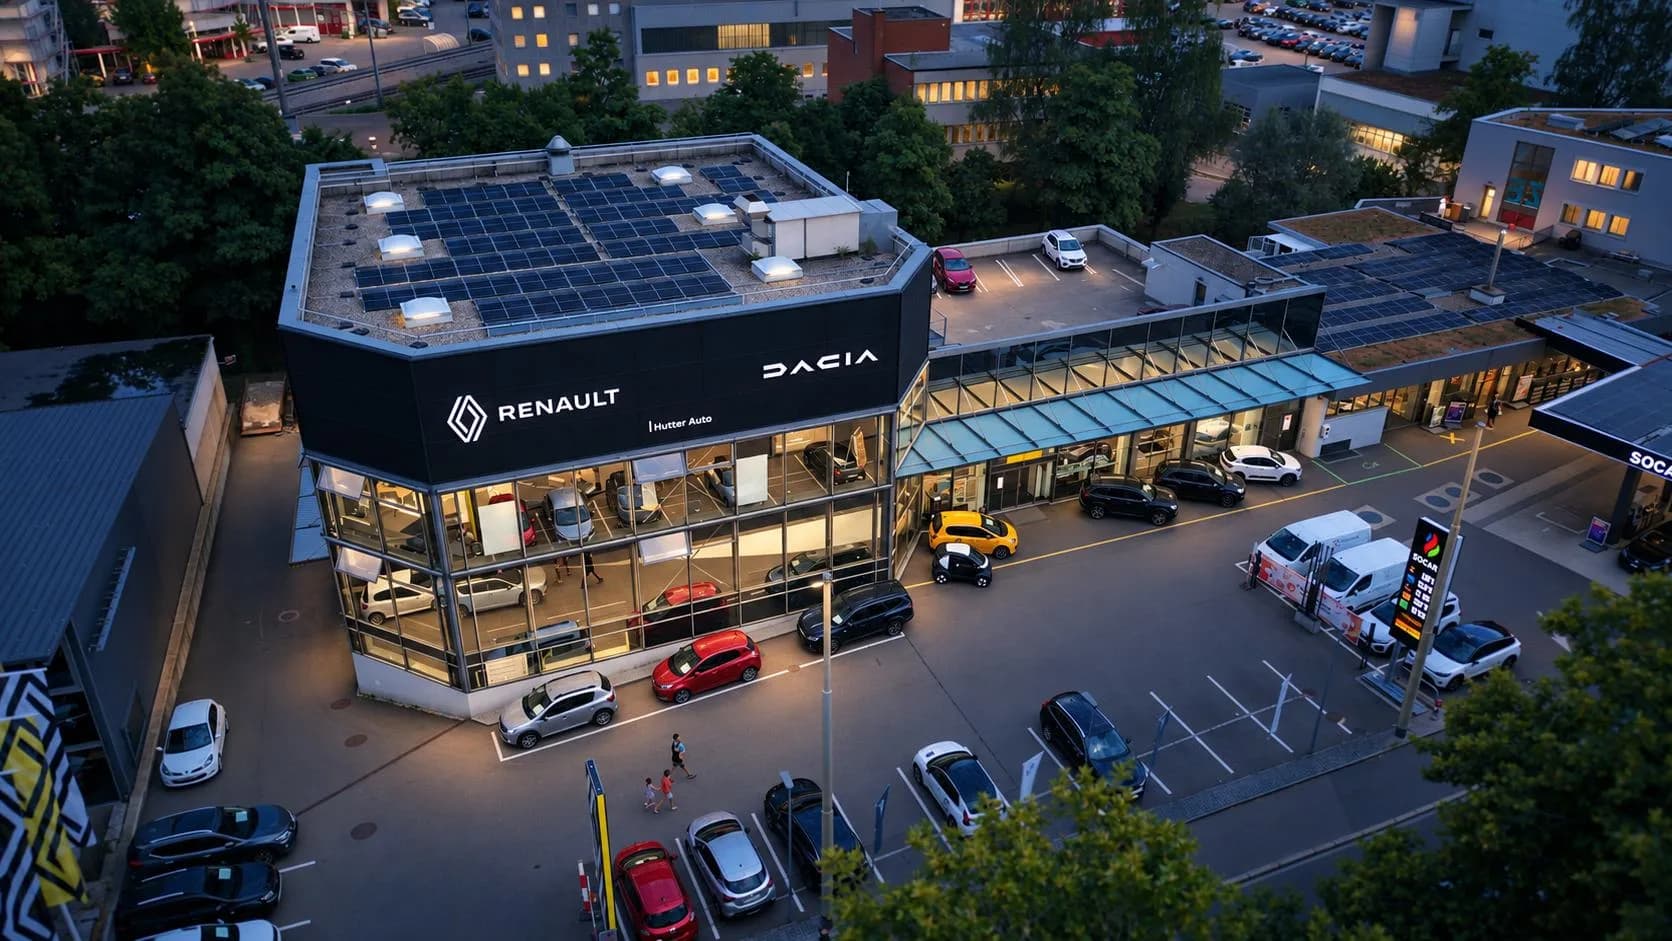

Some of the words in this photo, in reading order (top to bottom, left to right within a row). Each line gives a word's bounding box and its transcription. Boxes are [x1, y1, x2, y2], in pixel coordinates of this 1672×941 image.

[762, 350, 879, 379] DACIA
[498, 388, 620, 422] RENAULT
[653, 418, 687, 432] Hutter
[688, 415, 713, 427] Auto
[1412, 553, 1438, 573] SOCAR
